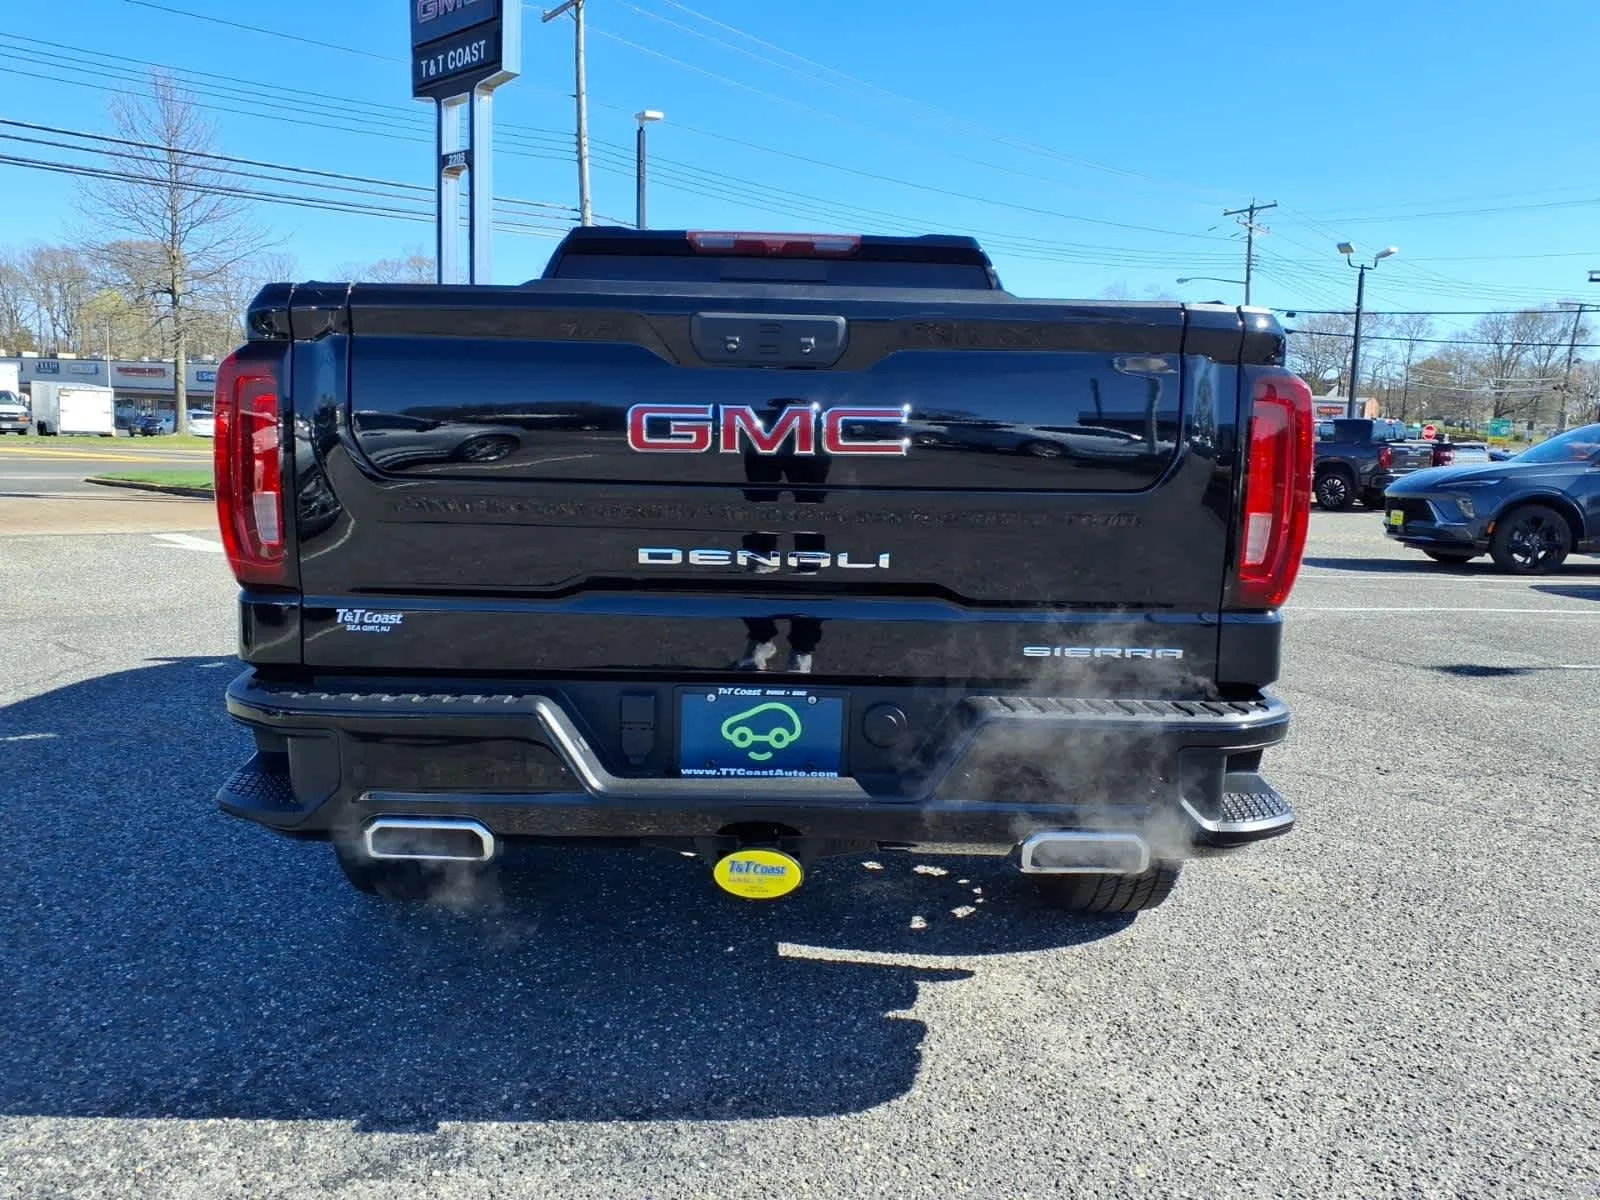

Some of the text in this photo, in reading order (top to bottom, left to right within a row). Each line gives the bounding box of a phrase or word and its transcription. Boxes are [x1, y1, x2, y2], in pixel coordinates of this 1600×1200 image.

[417, 0, 478, 24] GM
[421, 40, 486, 78] T&T COAST
[627, 403, 911, 455] GMC
[637, 548, 890, 569] DENALI
[335, 608, 404, 624] T&T Coast
[1023, 646, 1184, 660] SIERRA
[733, 687, 762, 696] Coast
[680, 767, 839, 778] www.TTCoastAuto.com
[729, 860, 786, 876] T&T Coast
